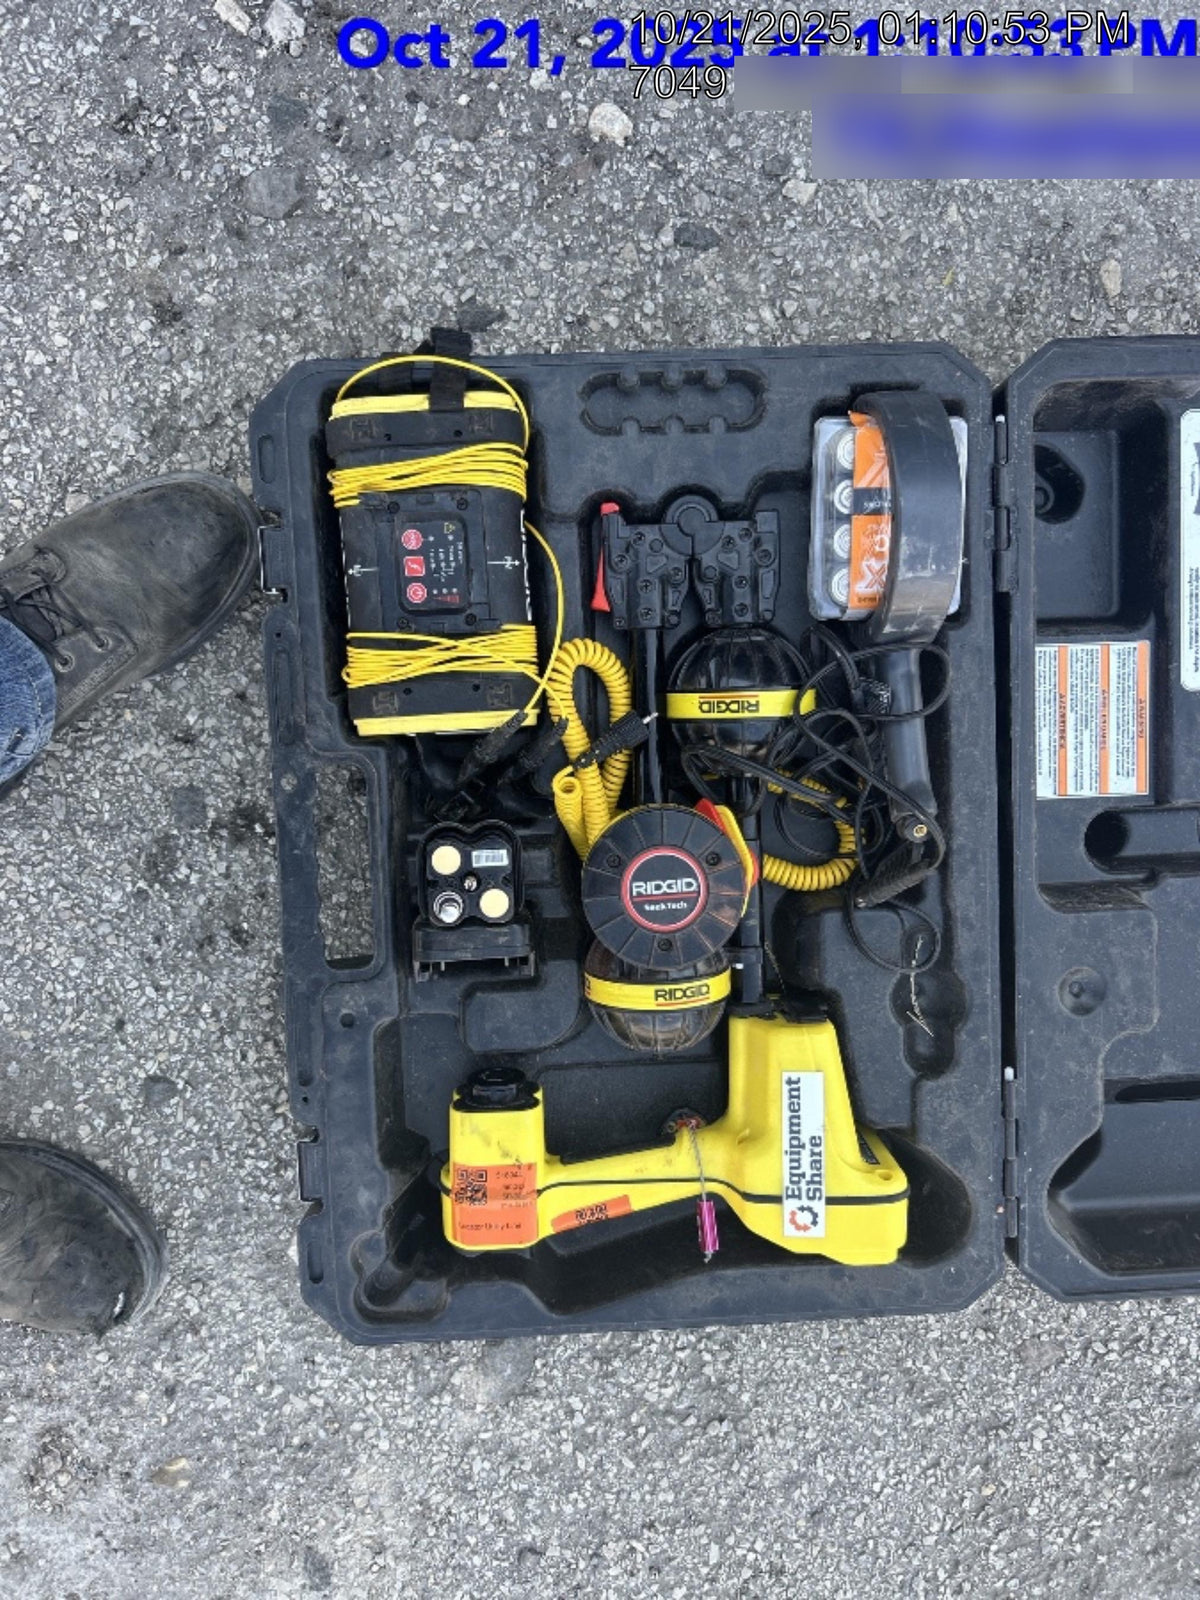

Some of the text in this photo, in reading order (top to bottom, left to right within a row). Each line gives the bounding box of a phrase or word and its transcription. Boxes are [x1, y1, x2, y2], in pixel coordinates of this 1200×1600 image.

[699, 700, 760, 713] RIDGID
[632, 878, 698, 896] RIDGID
[654, 984, 711, 1001] RIDGID
[785, 1077, 806, 1200] Equipment
[805, 1136, 823, 1201] Share
